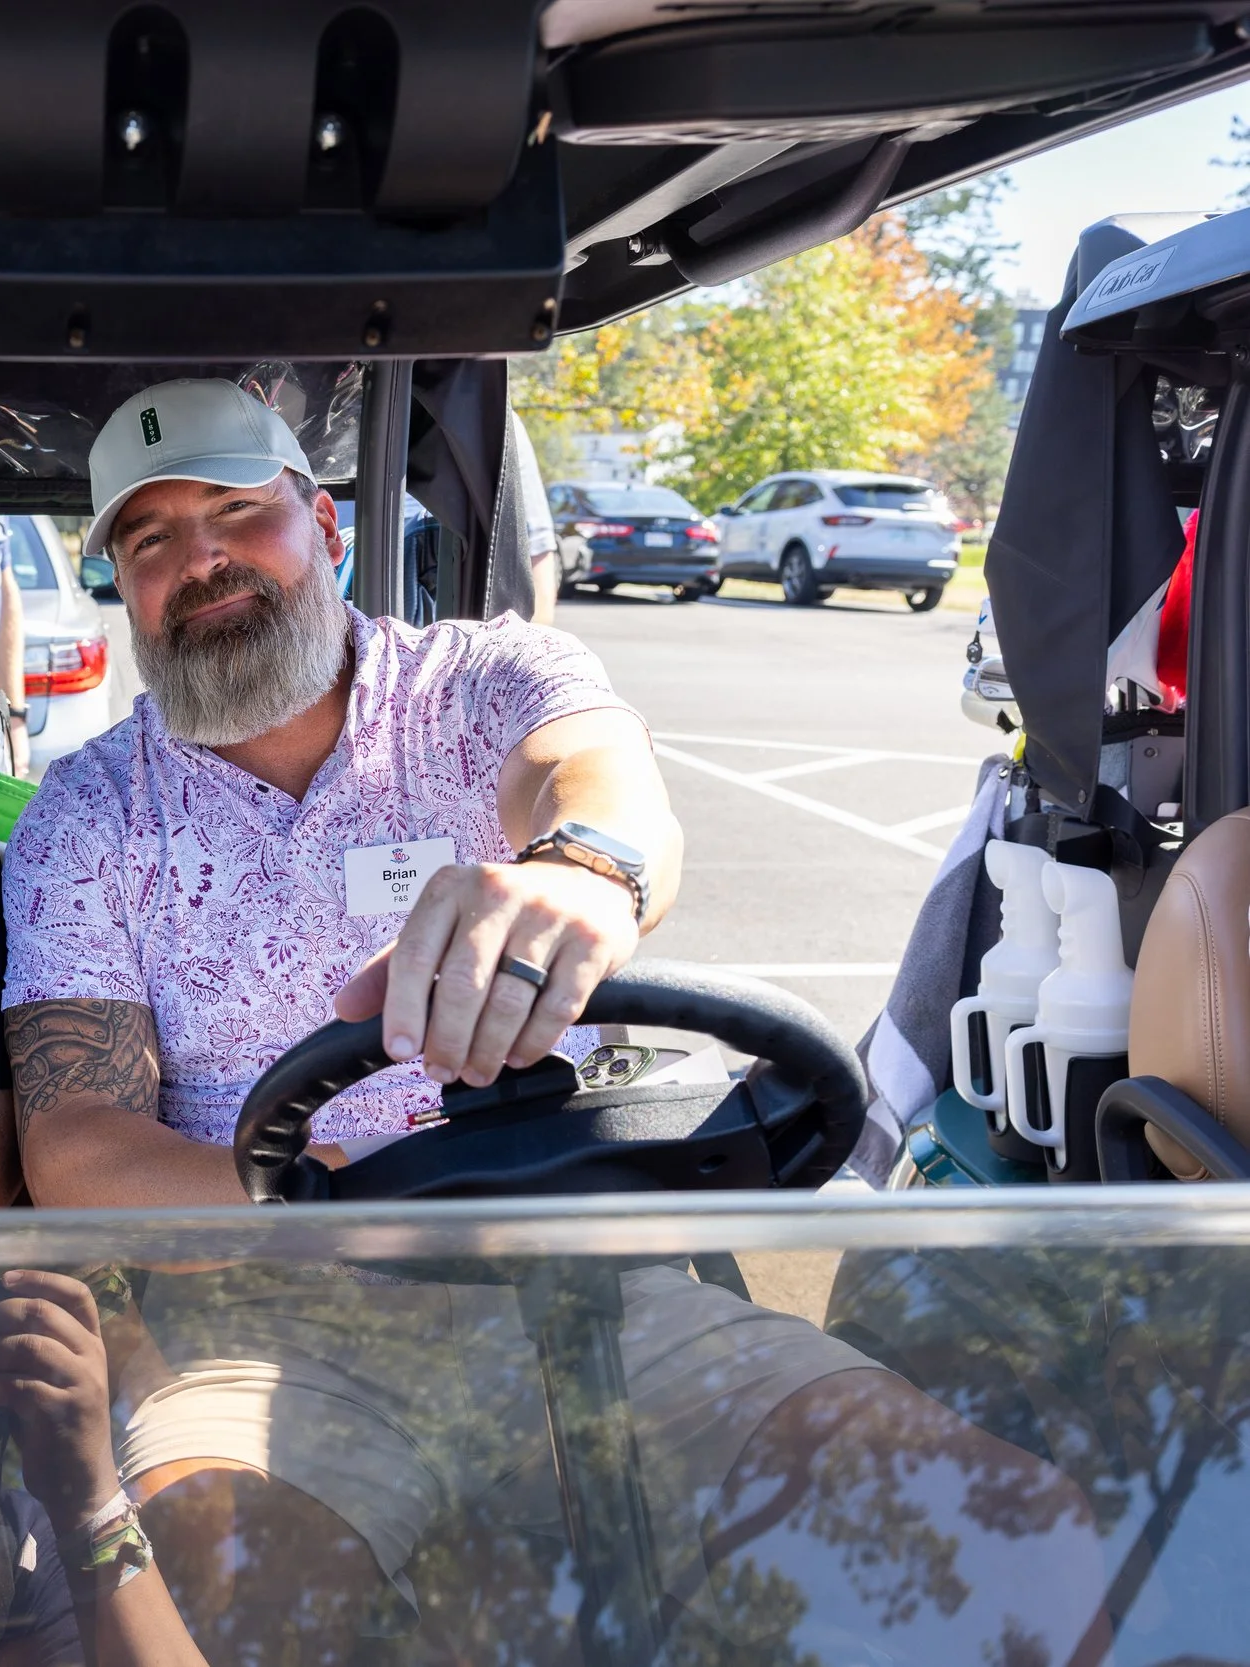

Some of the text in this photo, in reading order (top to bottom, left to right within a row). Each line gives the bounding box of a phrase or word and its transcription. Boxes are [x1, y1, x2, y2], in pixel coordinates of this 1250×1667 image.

[148, 418, 156, 442] 1896
[382, 869, 417, 881] Brian
[391, 883, 410, 893] Orr
